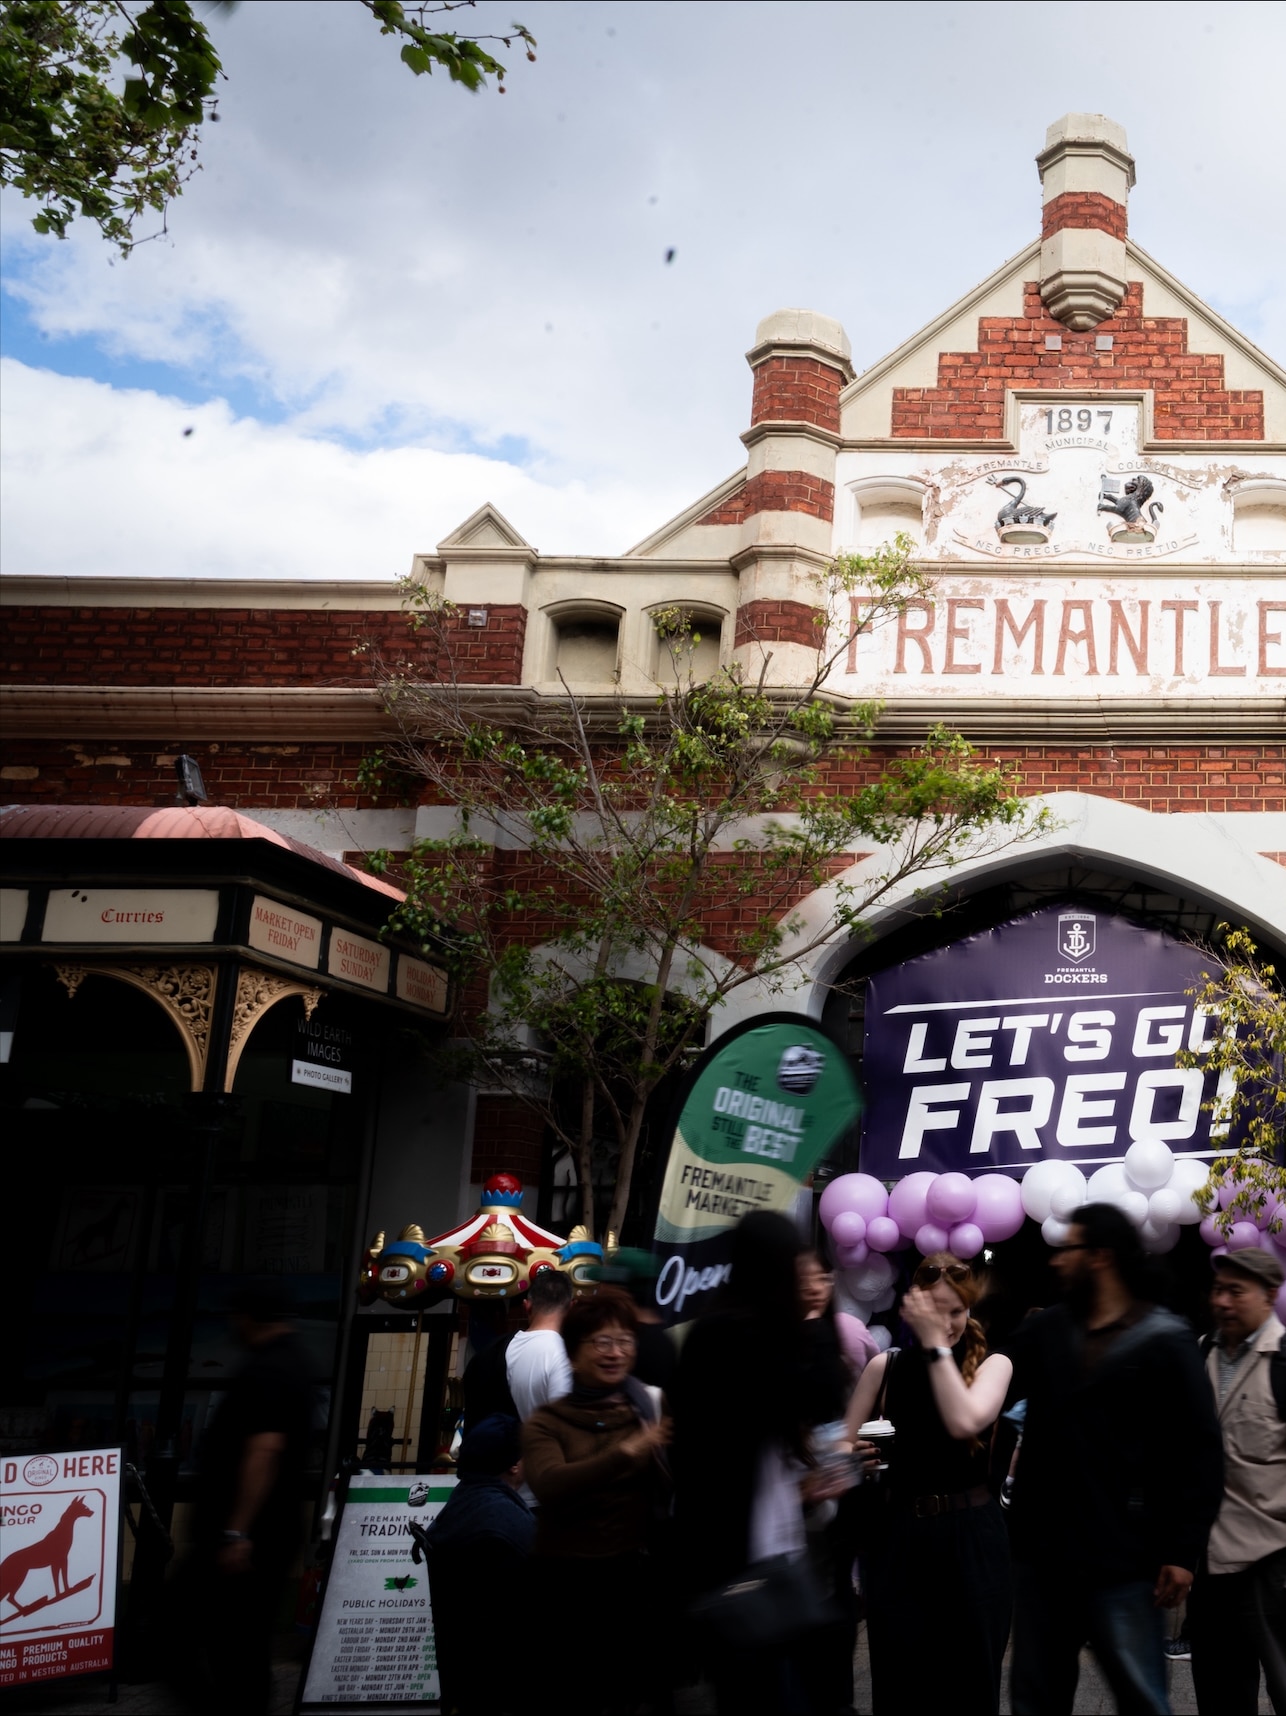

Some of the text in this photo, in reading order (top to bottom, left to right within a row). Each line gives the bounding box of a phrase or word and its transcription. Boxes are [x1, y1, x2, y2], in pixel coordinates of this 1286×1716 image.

[1043, 408, 1114, 436] 1897
[1044, 437, 1111, 451] MUNICIPAL
[976, 458, 1172, 475] FREMANTLE COUNCIL
[976, 540, 1179, 557] NEC PRECE NEC PRETIO
[101, 908, 165, 924] Curries
[255, 906, 316, 941] MARKET OPEN
[268, 928, 300, 951] FRIDAY
[336, 938, 383, 967] SATURDAY
[340, 958, 376, 983] SUNDAY
[406, 966, 437, 987] HOLIDAY
[1044, 973, 1108, 984] DOCKERS
[406, 985, 436, 1004] MONDAY
[297, 1018, 352, 1047] WILD EARTH
[903, 1004, 1238, 1074] LET'S GO
[307, 1040, 342, 1062] IMAGES
[303, 1069, 343, 1084] PHOTO GALLERY
[734, 1071, 762, 1092] THE
[712, 1086, 806, 1134] ORIGINAL
[898, 1064, 1238, 1160] FREO!
[712, 1115, 744, 1137] STILL
[741, 1124, 803, 1163] BEST
[680, 1164, 775, 1202] FREMANTLE
[63, 1454, 118, 1478] HERE
[360, 1524, 423, 1537] TRADIN
[342, 1599, 376, 1608] PUBLIC
[378, 1599, 426, 1608] HOLIDAYS
[337, 1618, 351, 1626] NEW
[365, 1617, 375, 1625] DAY
[379, 1617, 405, 1625] THURSDAY
[339, 1627, 364, 1635] AUSTRALIA
[23, 1641, 63, 1656] PREMIUM
[68, 1634, 104, 1649] QUALITY
[409, 1635, 421, 1643] MAR
[19, 1671, 27, 1679] IN
[32, 1665, 66, 1678] WESTERN
[70, 1658, 109, 1671] AUSTRALIA
[22, 1651, 68, 1667] PRODUCTS
[331, 1665, 349, 1673] EASTER
[361, 1683, 383, 1691] MONDAY
[404, 1692, 417, 1700] SEPT
